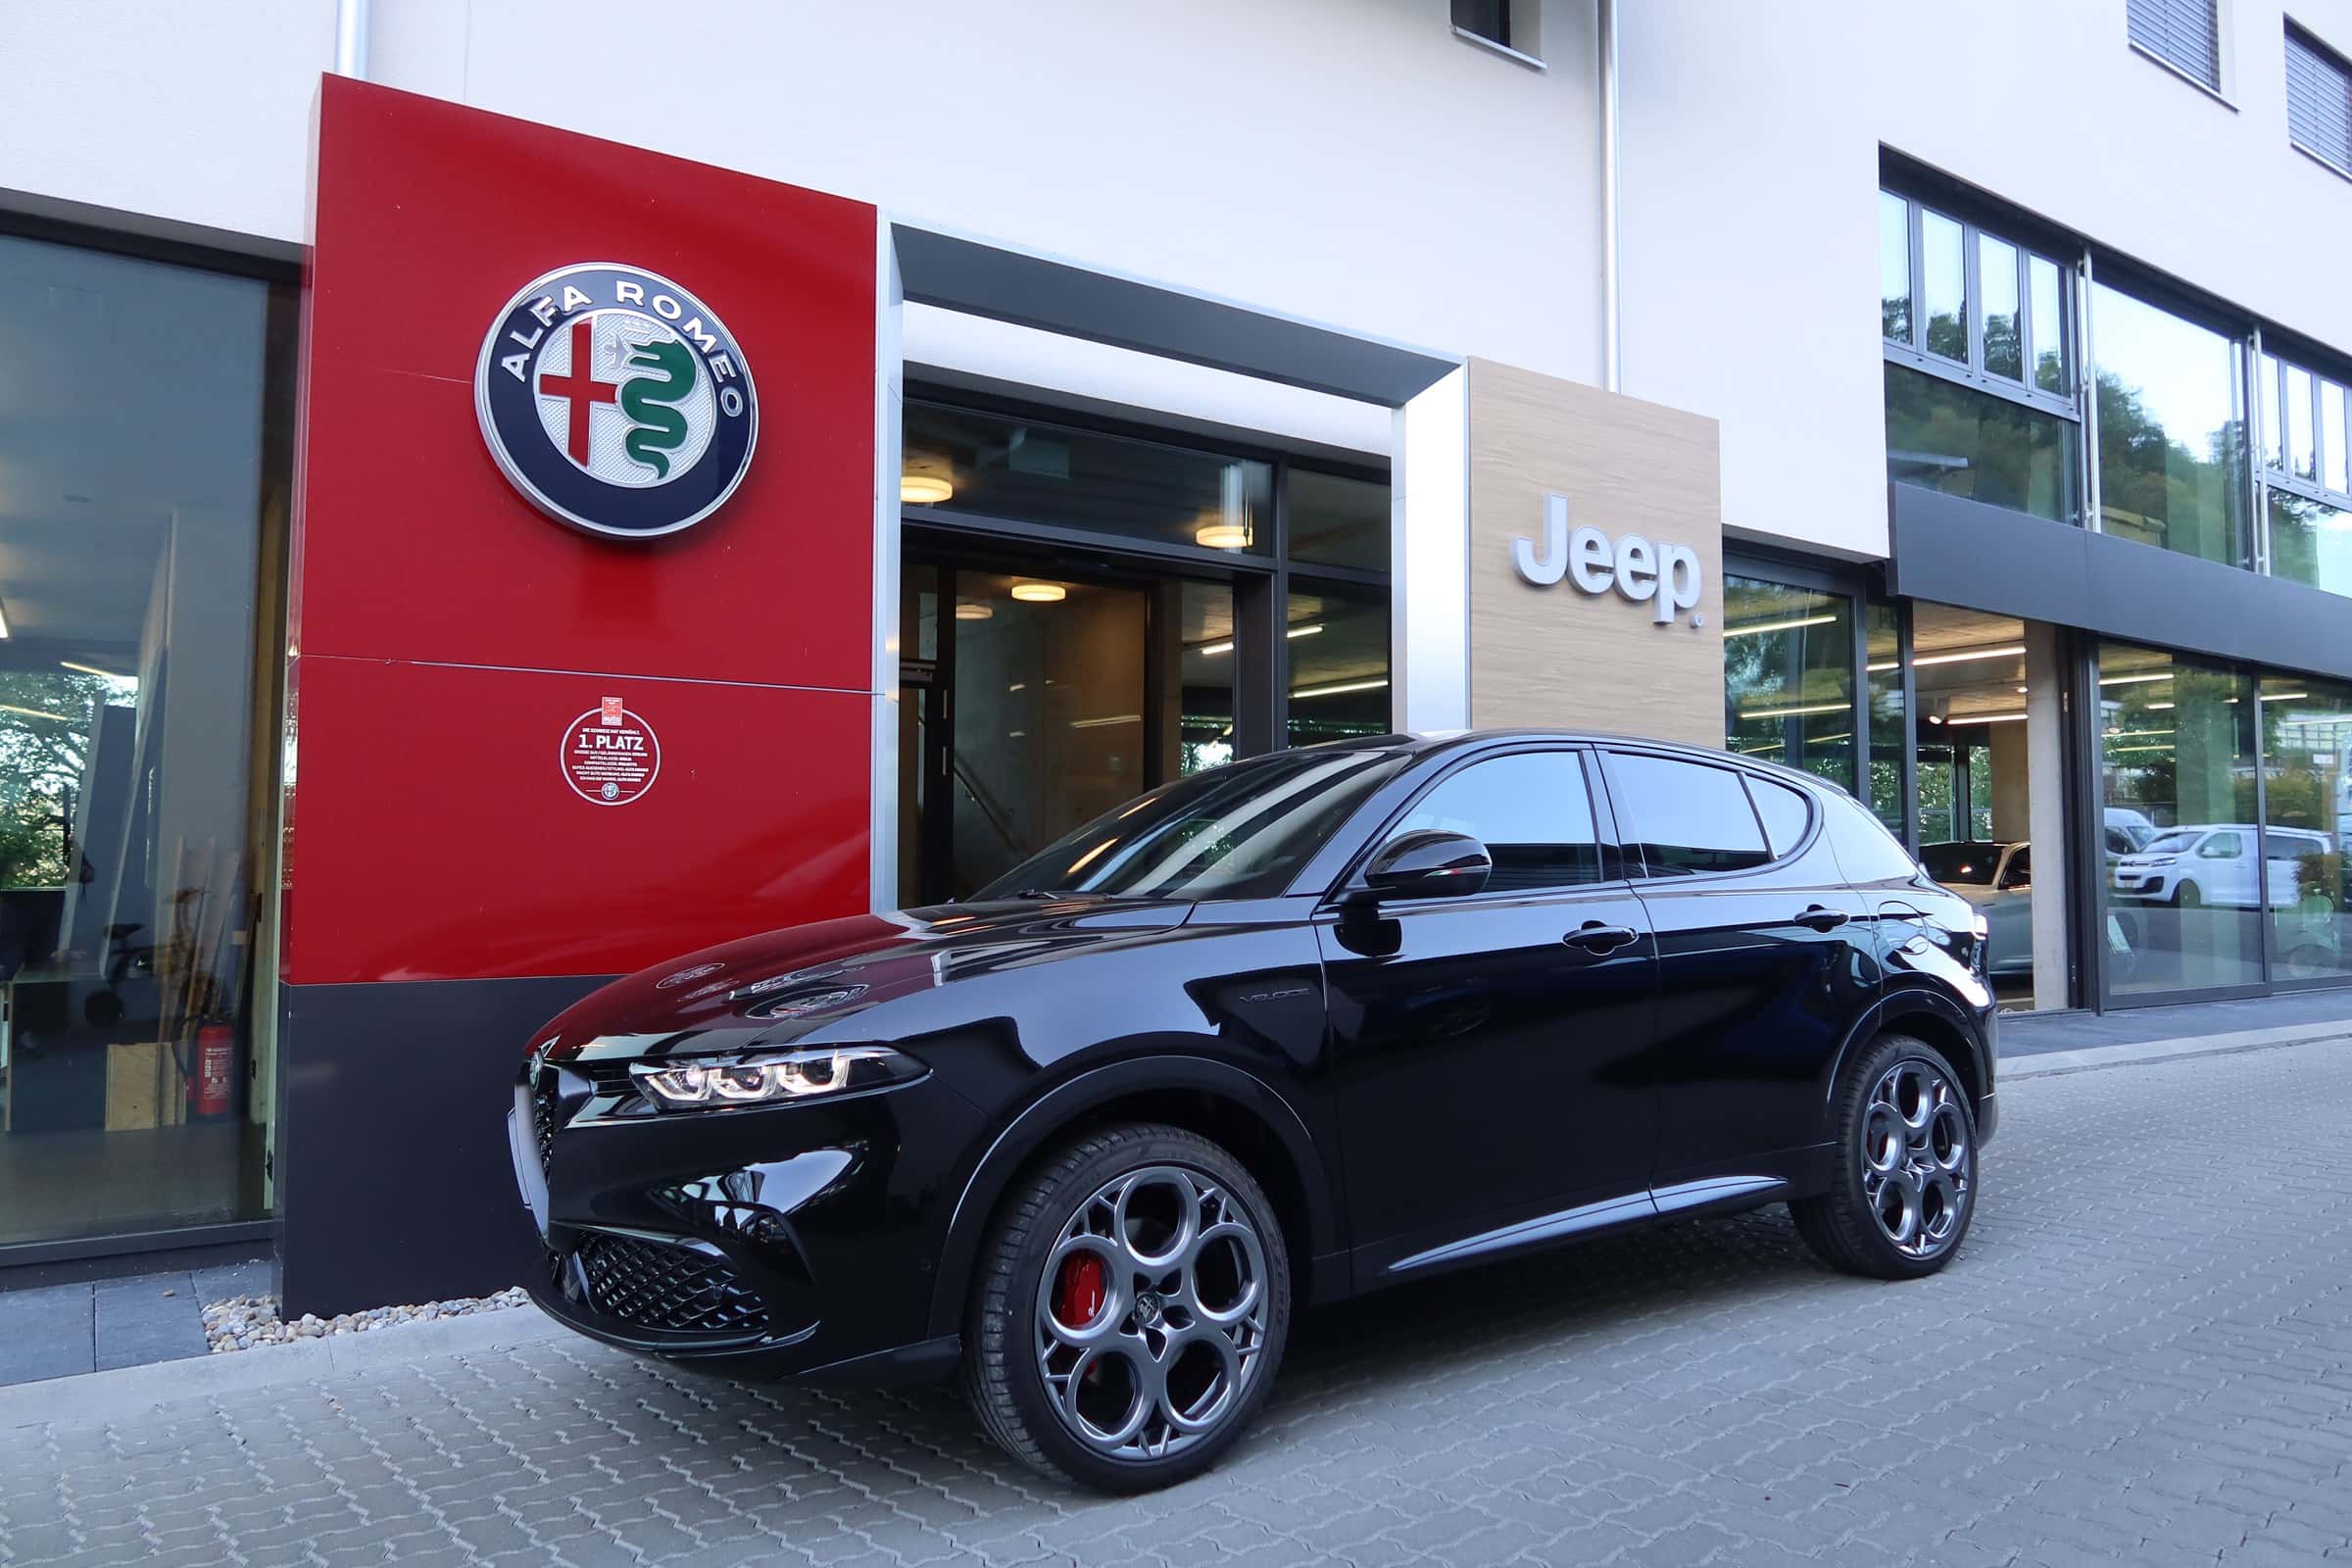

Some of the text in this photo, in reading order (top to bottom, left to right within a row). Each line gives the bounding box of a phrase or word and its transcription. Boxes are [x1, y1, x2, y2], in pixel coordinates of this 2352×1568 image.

[501, 280, 743, 417] ALFA ROMEO
[578, 734, 644, 750] 1. PLATZ
